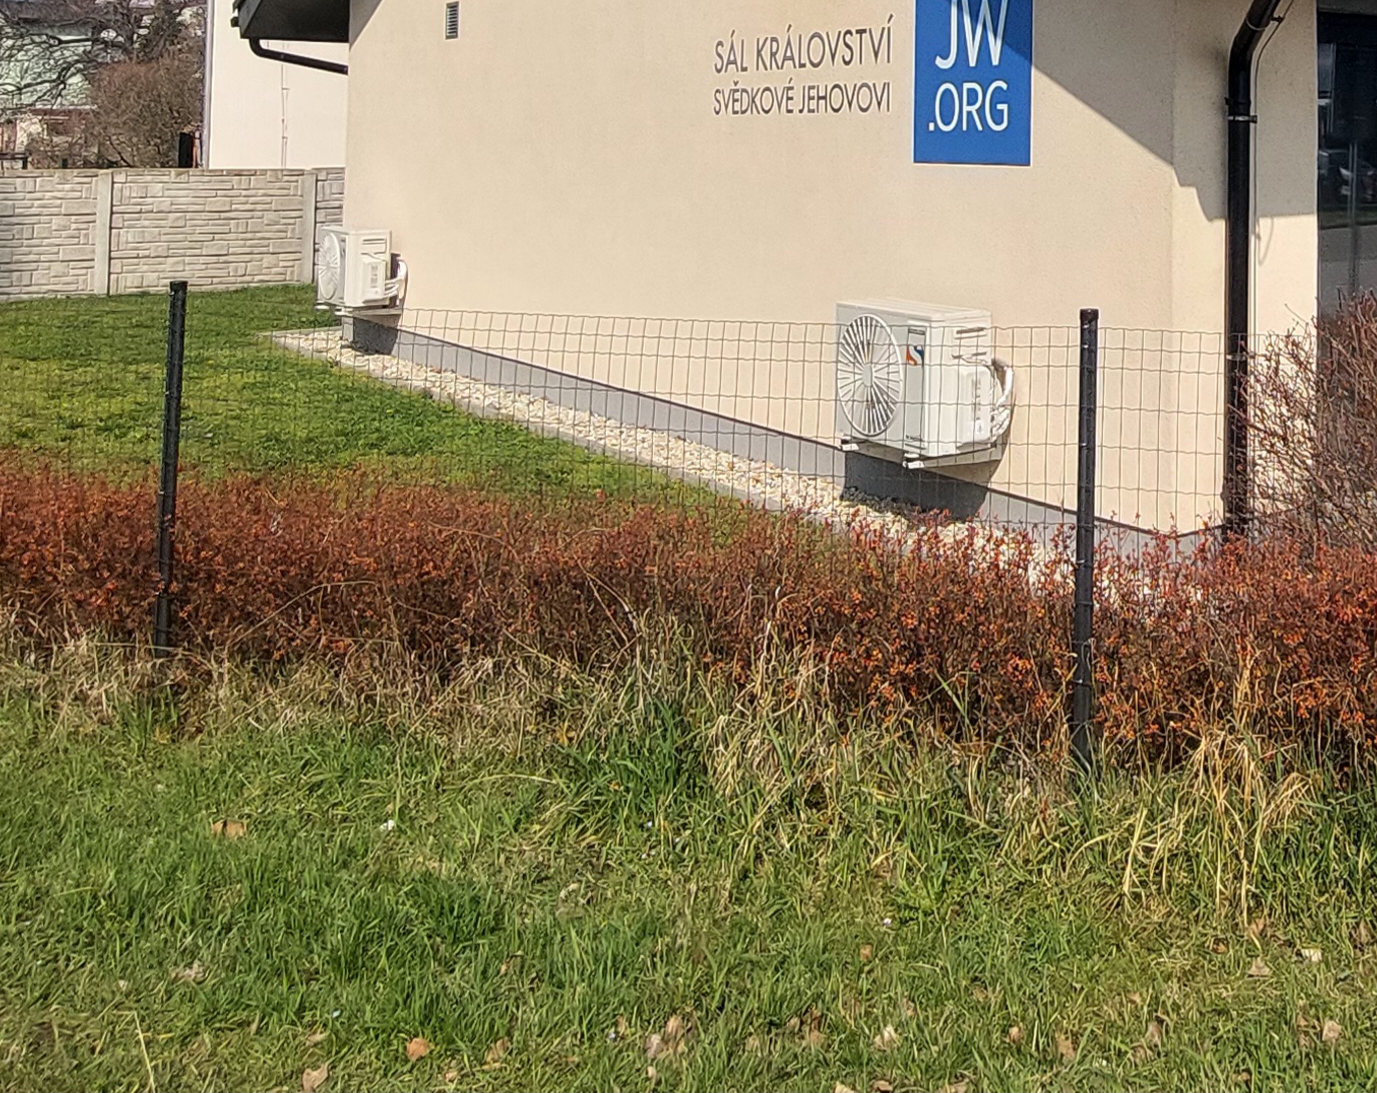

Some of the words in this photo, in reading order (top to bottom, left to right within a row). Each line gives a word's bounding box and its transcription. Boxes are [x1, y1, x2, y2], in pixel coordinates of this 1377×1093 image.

[713, 29, 748, 74] SÁL
[756, 13, 894, 71] KRÁLOVSTVÍ
[713, 77, 795, 116] SVĚDKOVÉ
[798, 82, 891, 114] JEHOVOVI
[927, 80, 1009, 133] .ORG
